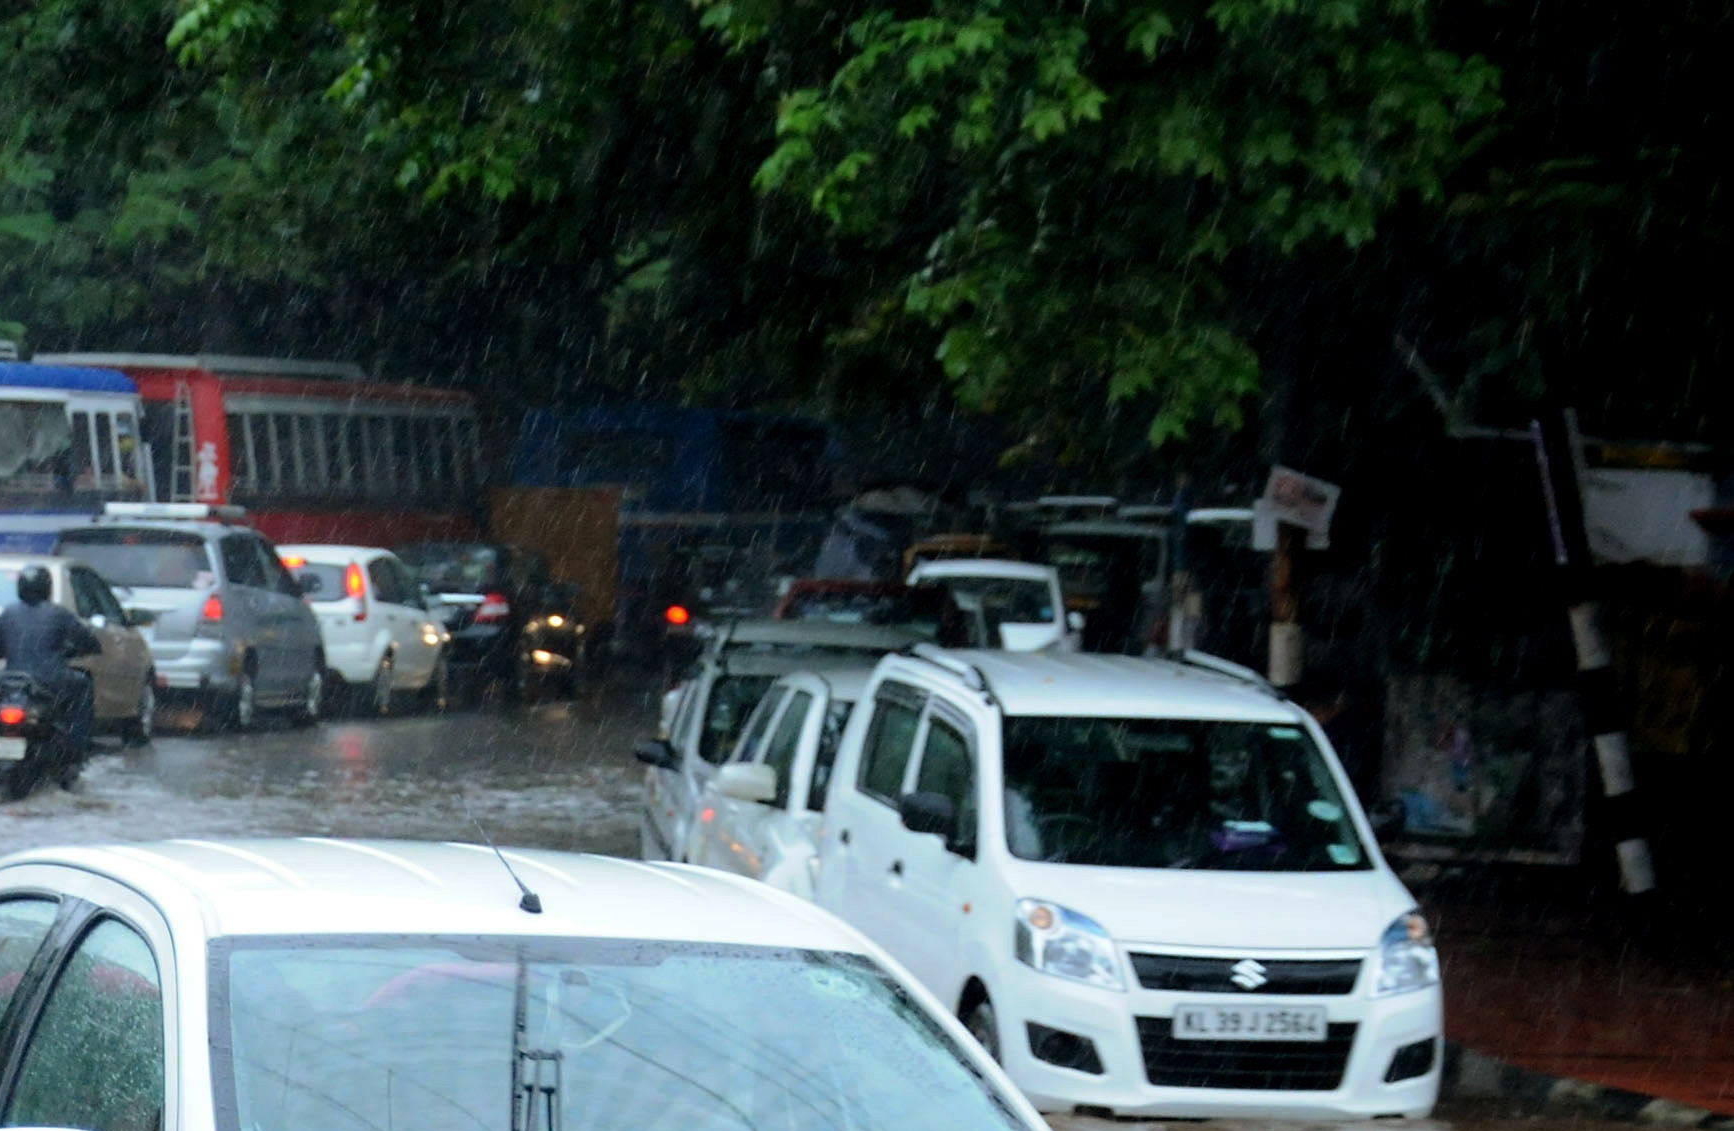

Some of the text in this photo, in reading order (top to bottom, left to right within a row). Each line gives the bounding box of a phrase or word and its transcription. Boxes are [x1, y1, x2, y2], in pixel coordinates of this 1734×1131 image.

[1184, 1011, 1208, 1032] KL
[1217, 1011, 1242, 1032] 39
[1249, 1011, 1260, 1032] J
